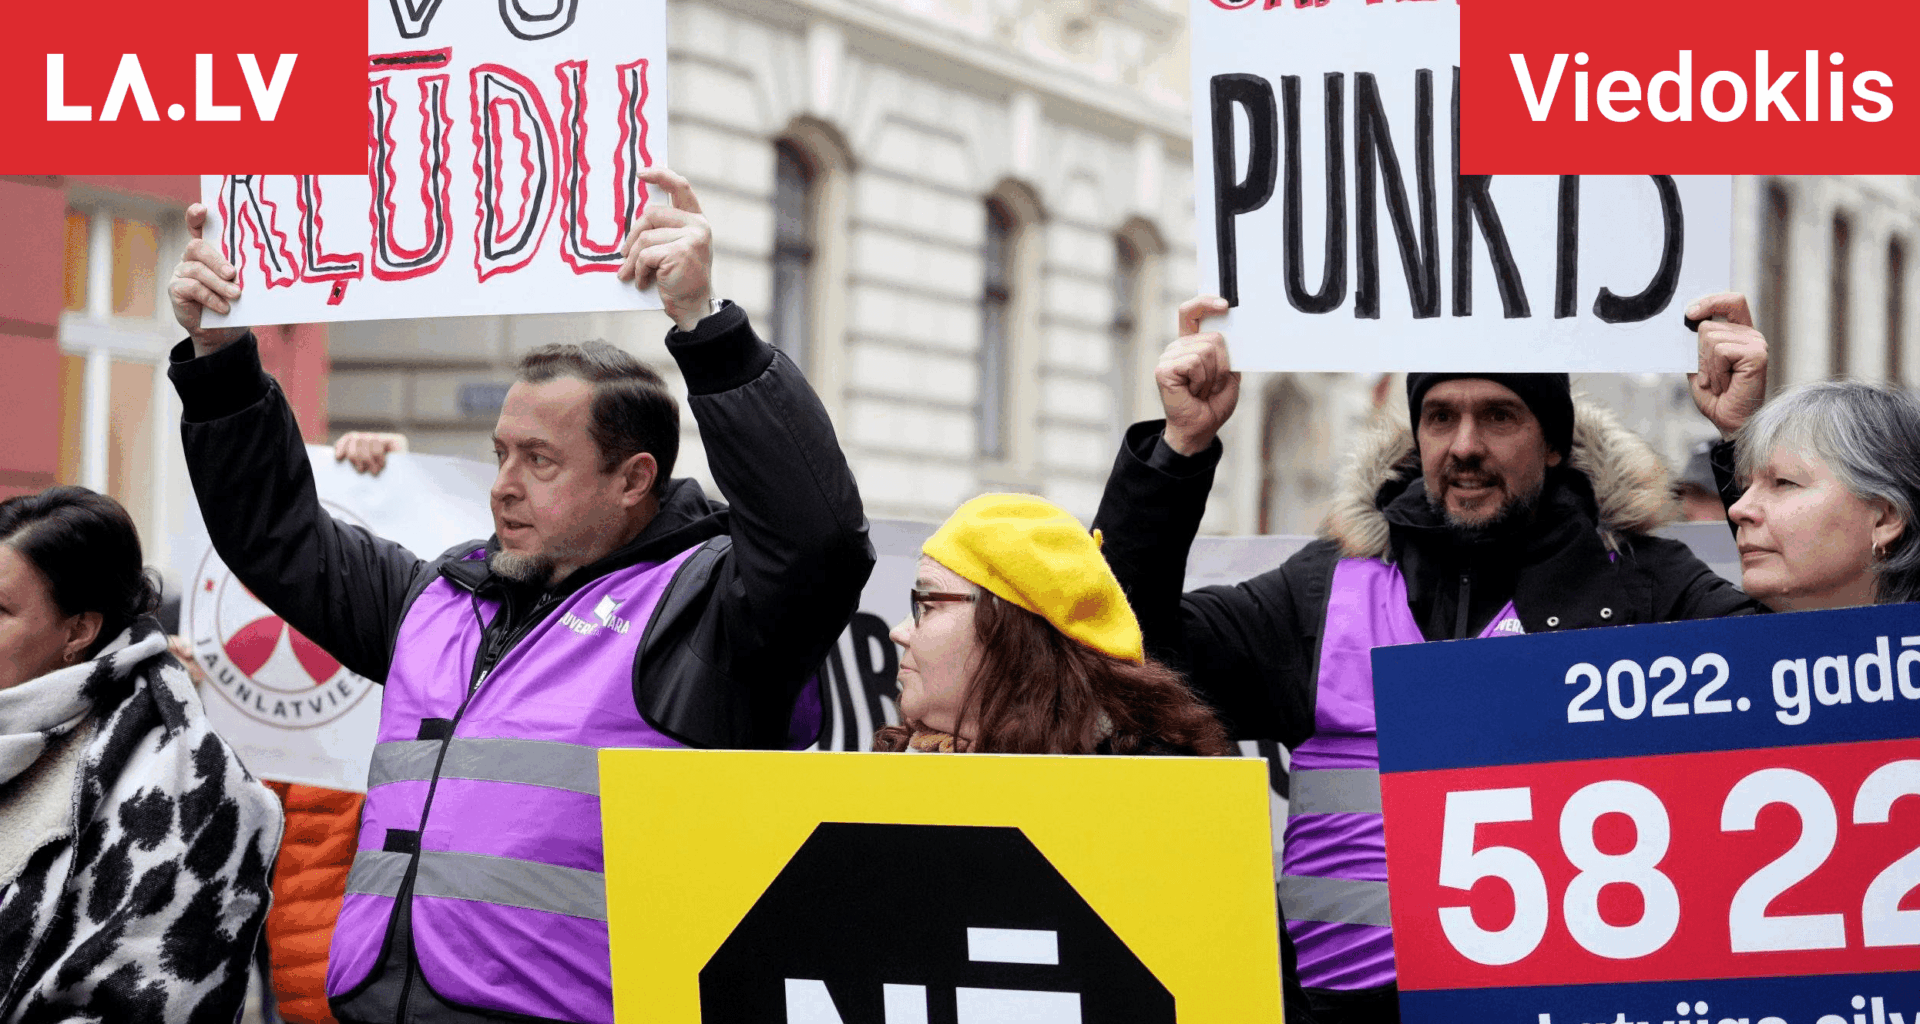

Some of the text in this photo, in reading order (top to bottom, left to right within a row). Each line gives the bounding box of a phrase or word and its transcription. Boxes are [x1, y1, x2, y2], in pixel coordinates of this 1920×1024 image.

[196, 635, 363, 718] JAUNLATVIE
[1565, 653, 1751, 723] 2022.
[1437, 779, 1681, 966] 58
